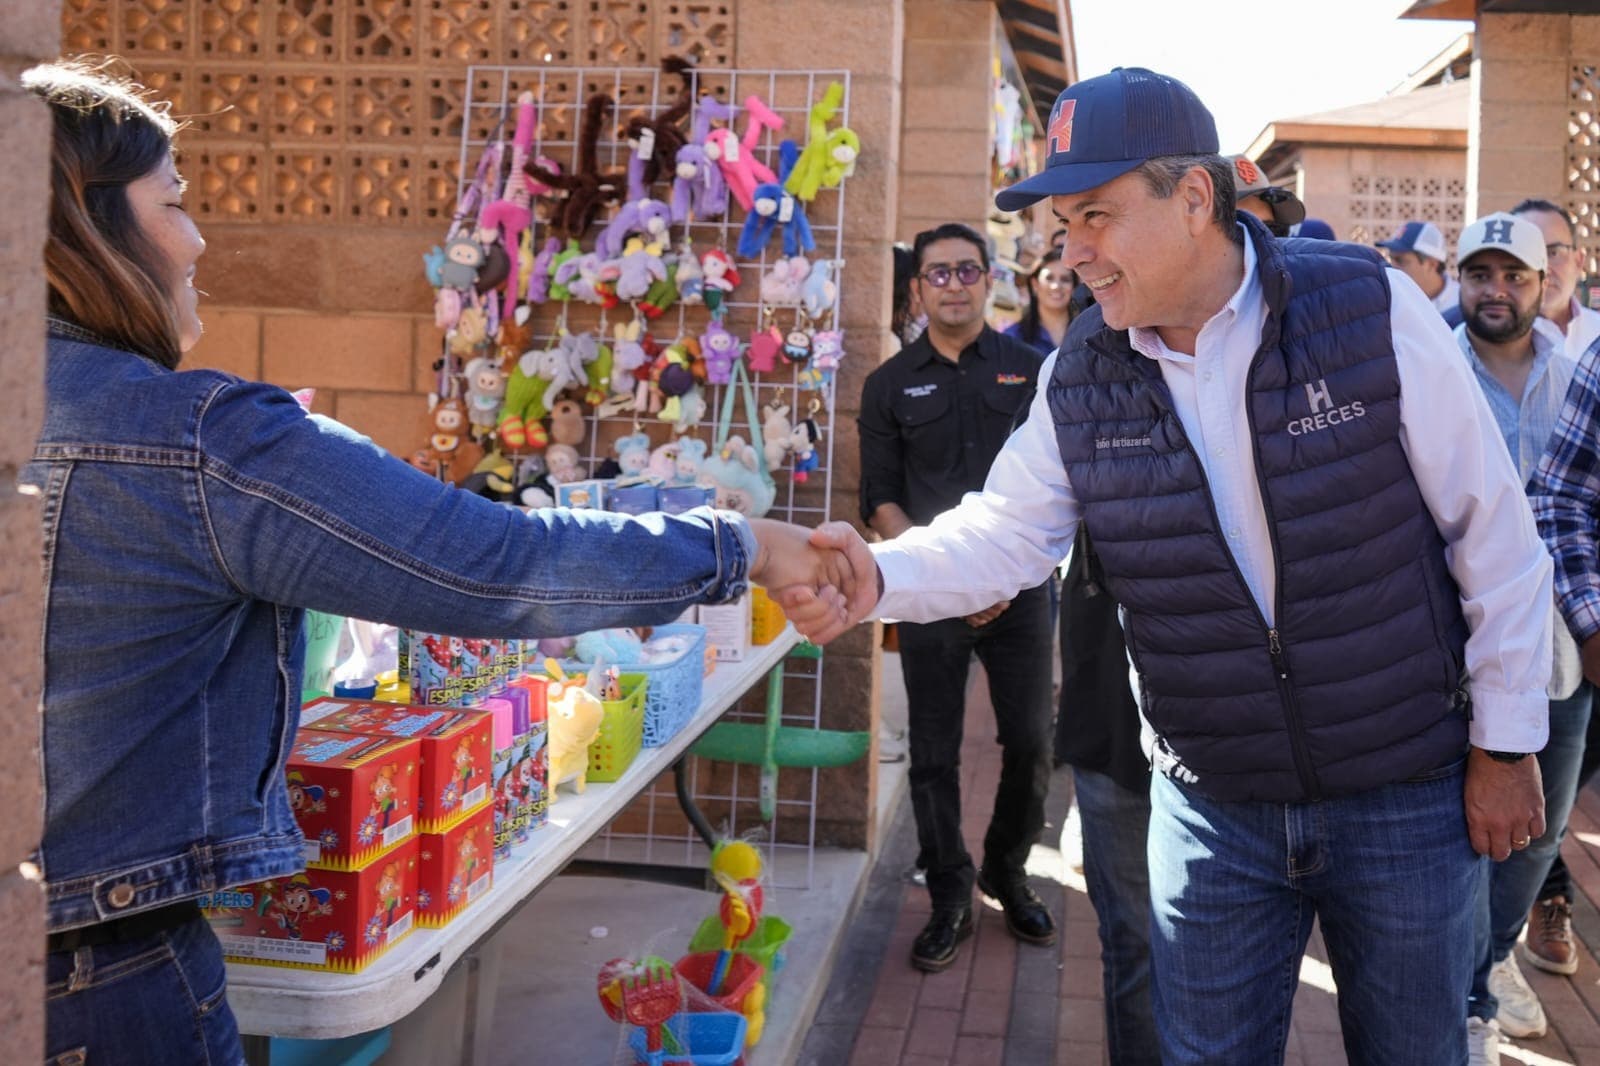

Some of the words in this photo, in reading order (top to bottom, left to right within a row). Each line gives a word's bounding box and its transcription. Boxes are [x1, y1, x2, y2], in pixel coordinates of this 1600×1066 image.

[1481, 219, 1514, 244] H
[1305, 379, 1334, 414] H
[1287, 401, 1366, 436] CRECES
